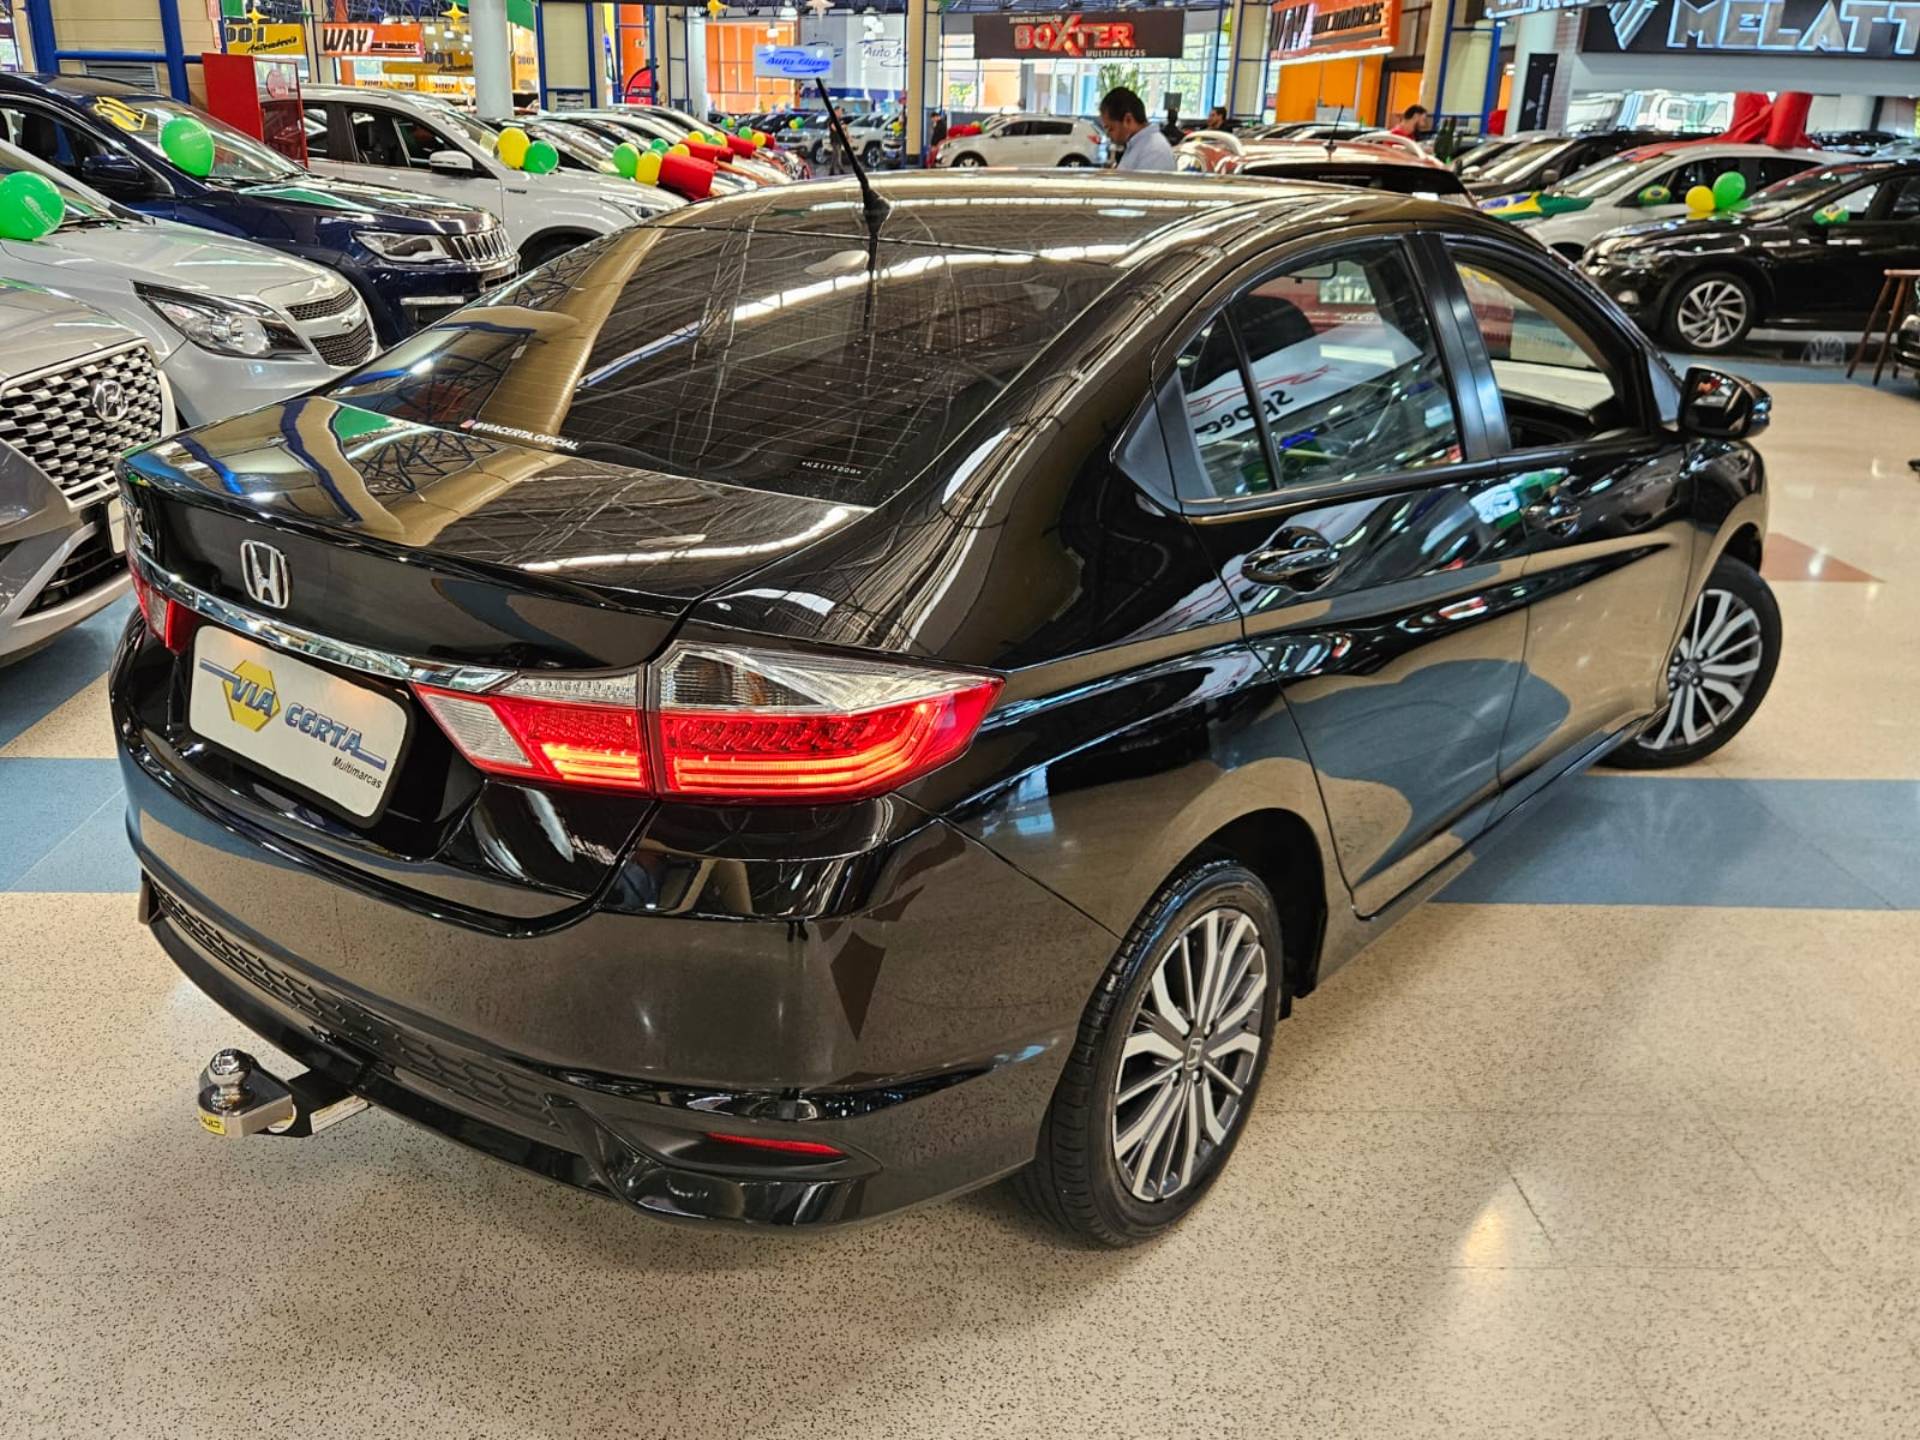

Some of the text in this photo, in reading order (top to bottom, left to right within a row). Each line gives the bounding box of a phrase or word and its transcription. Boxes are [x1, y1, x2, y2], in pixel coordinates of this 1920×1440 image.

[323, 29, 370, 52] WAY
[1014, 14, 1134, 57] BOXTER
[1086, 48, 1146, 58] MULTIMARCAS
[231, 677, 363, 752] VIA CERTA
[332, 756, 383, 789] Multimarcas
